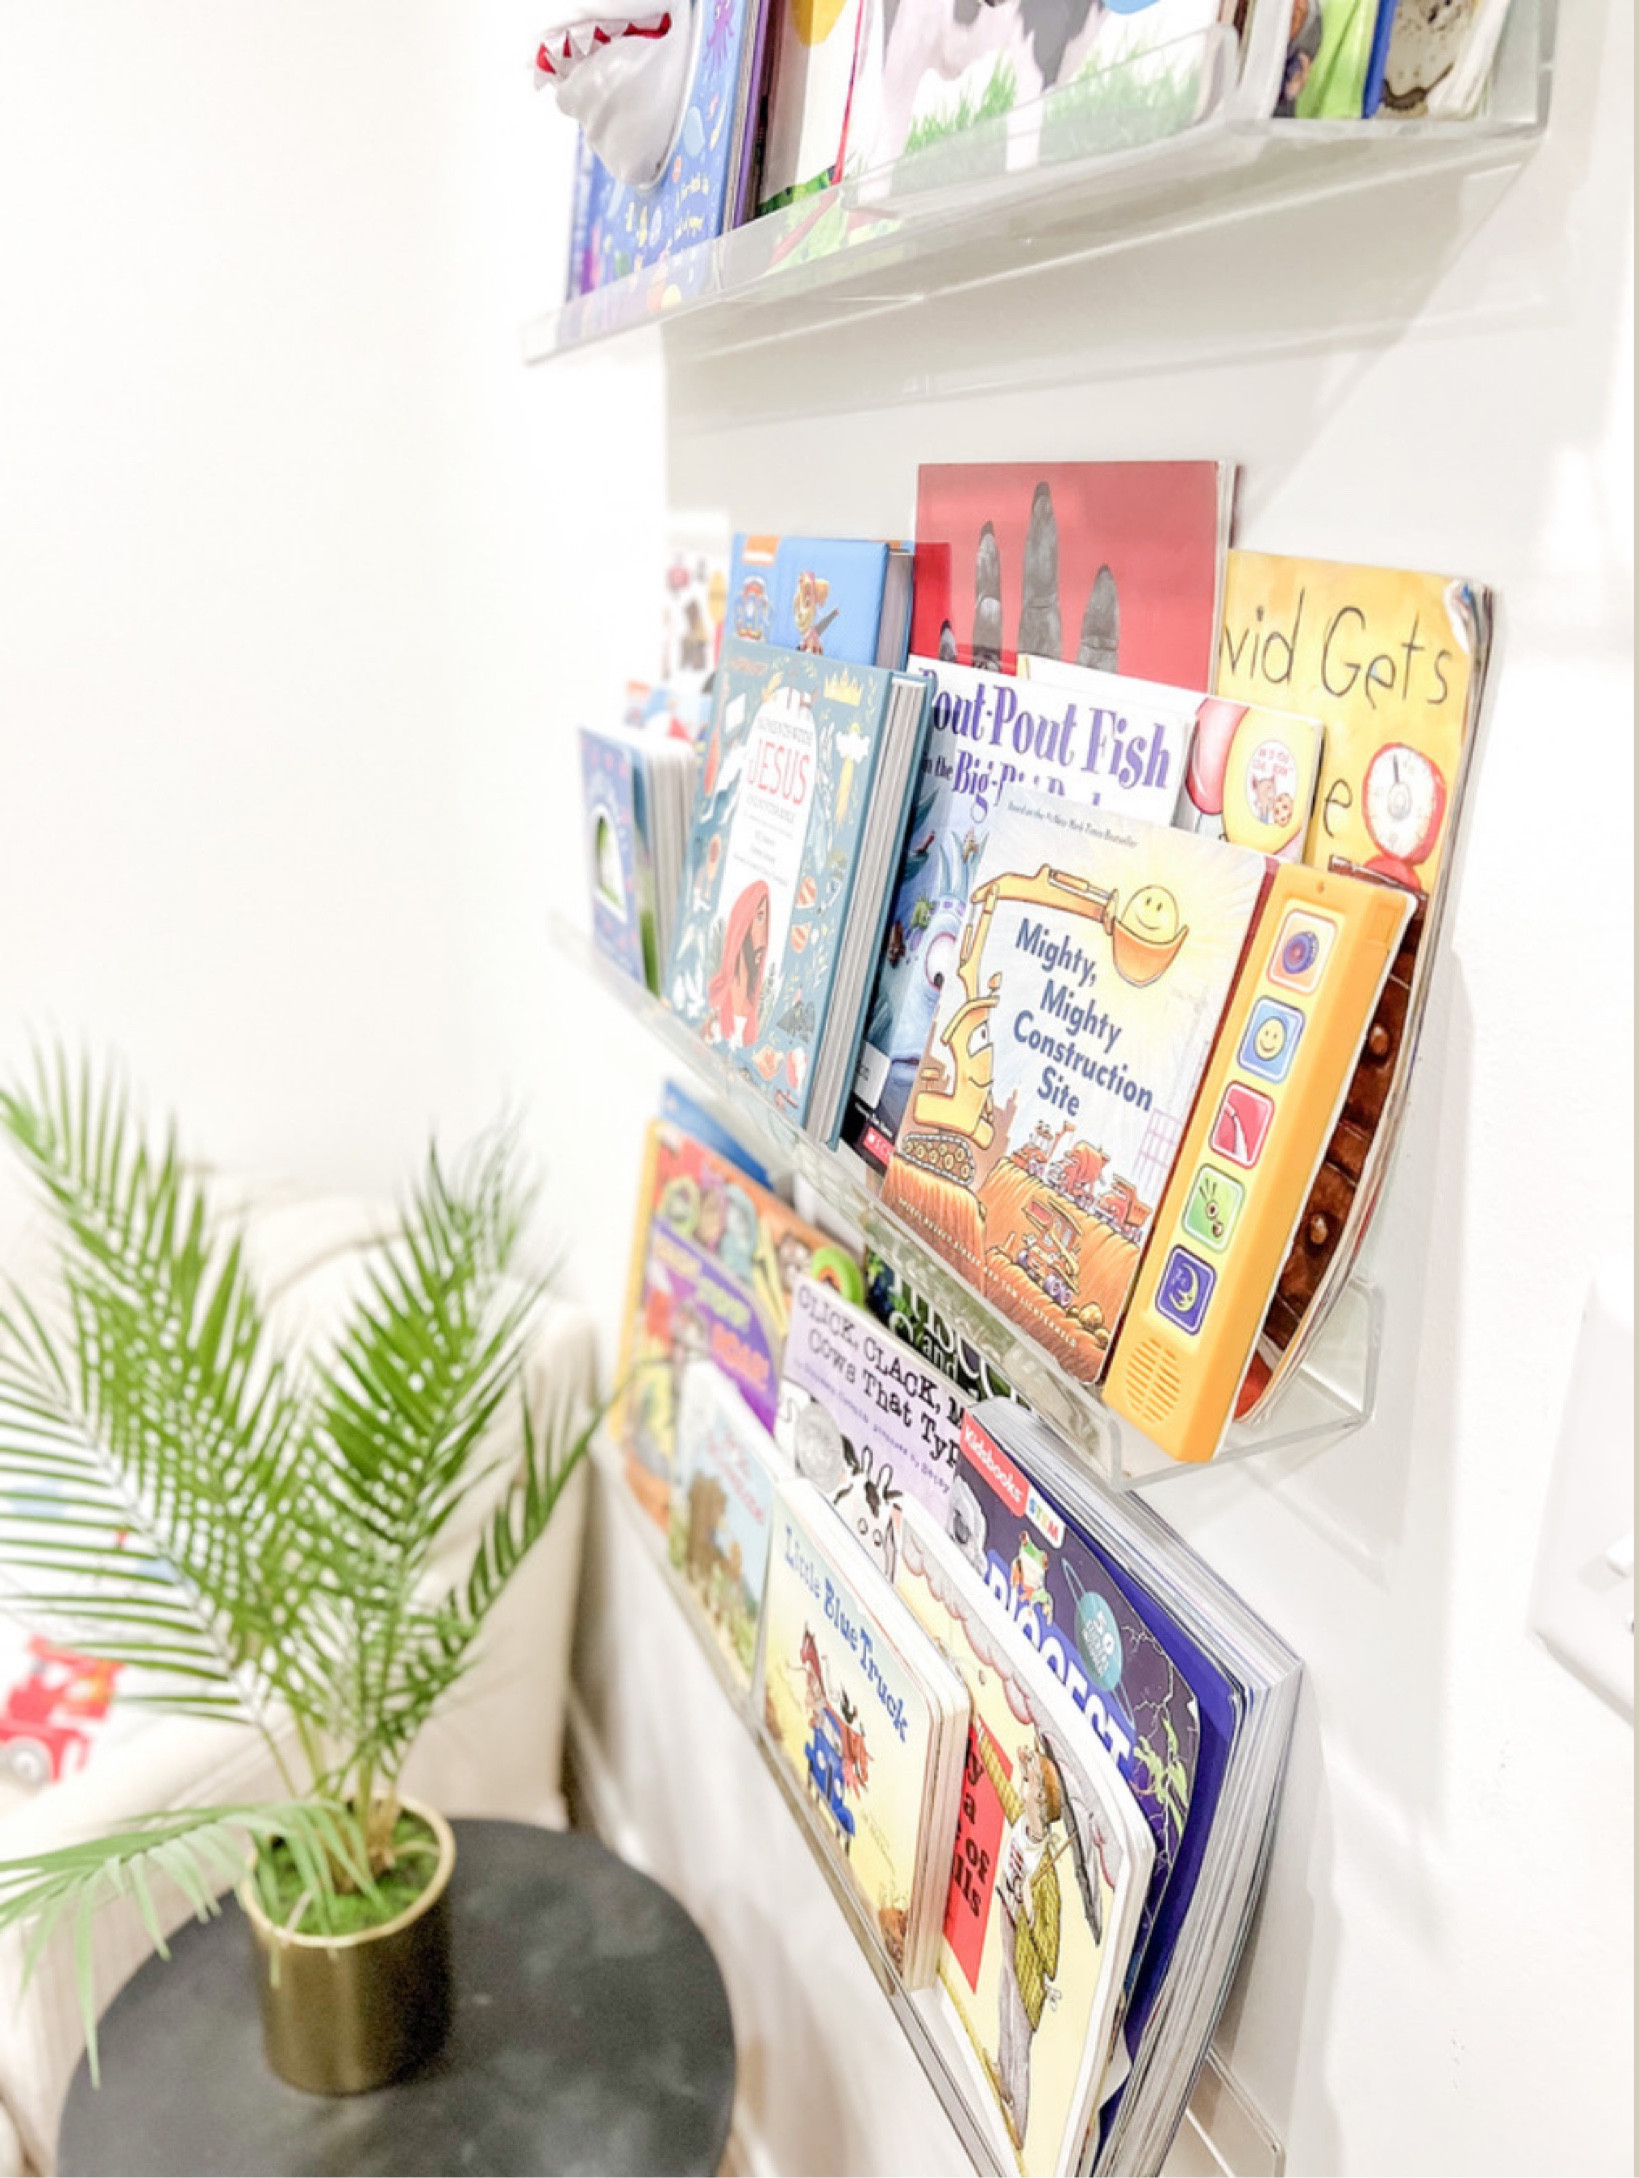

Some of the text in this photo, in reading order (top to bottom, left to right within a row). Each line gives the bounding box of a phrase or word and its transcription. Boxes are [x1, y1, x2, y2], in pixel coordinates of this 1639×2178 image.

[1321, 605, 1453, 710] Gets
[747, 737, 811, 806] JESUS
[1080, 706, 1171, 790] Fish
[1015, 917, 1097, 988] Mighty,
[1039, 978, 1123, 1054] Mighty
[1013, 1009, 1154, 1112] Construction
[1036, 1065, 1080, 1117] Site
[798, 1285, 859, 1349] CLICK,
[864, 1336, 942, 1415] CLACK,
[808, 1328, 857, 1385] Cows
[862, 1368, 913, 1428] That
[922, 1333, 959, 1383] and
[1028, 1497, 1059, 1542] STEM
[784, 1523, 909, 1744] Little Blue Truck
[965, 1836, 991, 1885] of
